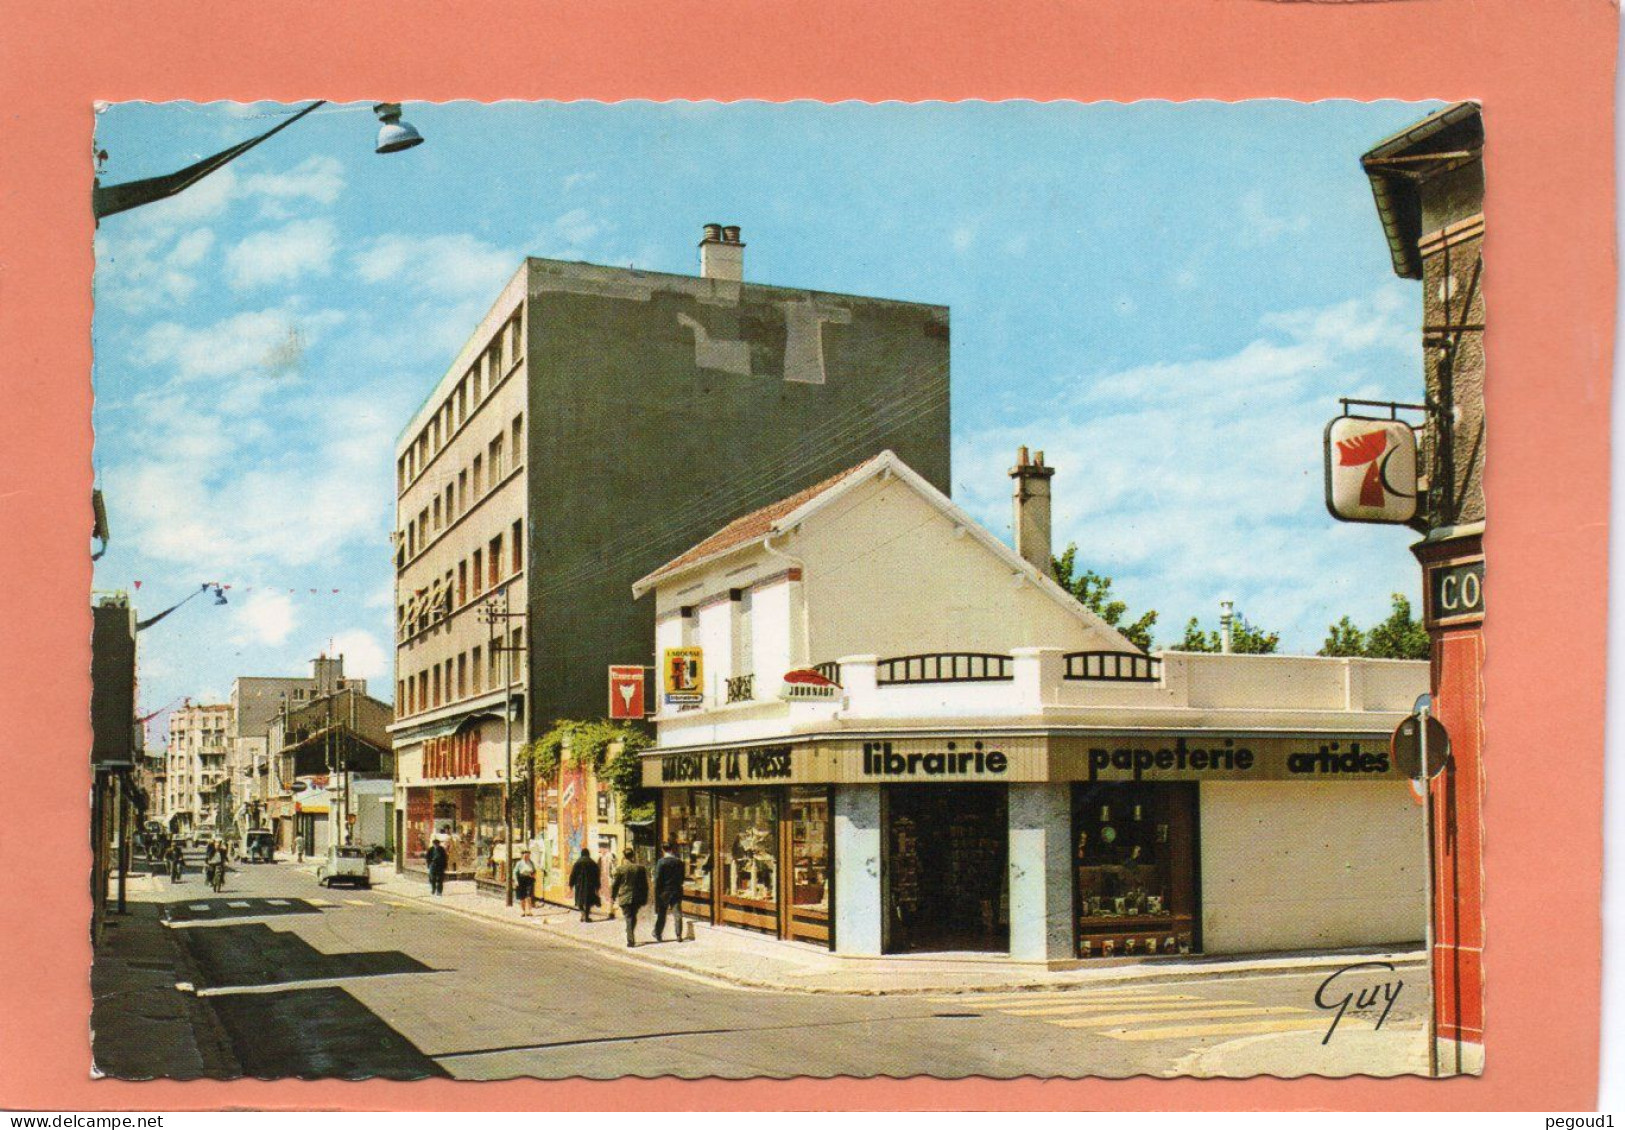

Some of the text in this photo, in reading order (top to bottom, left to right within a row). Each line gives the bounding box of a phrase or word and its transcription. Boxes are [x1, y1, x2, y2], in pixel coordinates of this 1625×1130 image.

[707, 751, 721, 781] DE
[726, 750, 741, 780] LA
[863, 741, 1008, 775] librairie
[1088, 738, 1254, 781] papeterie
